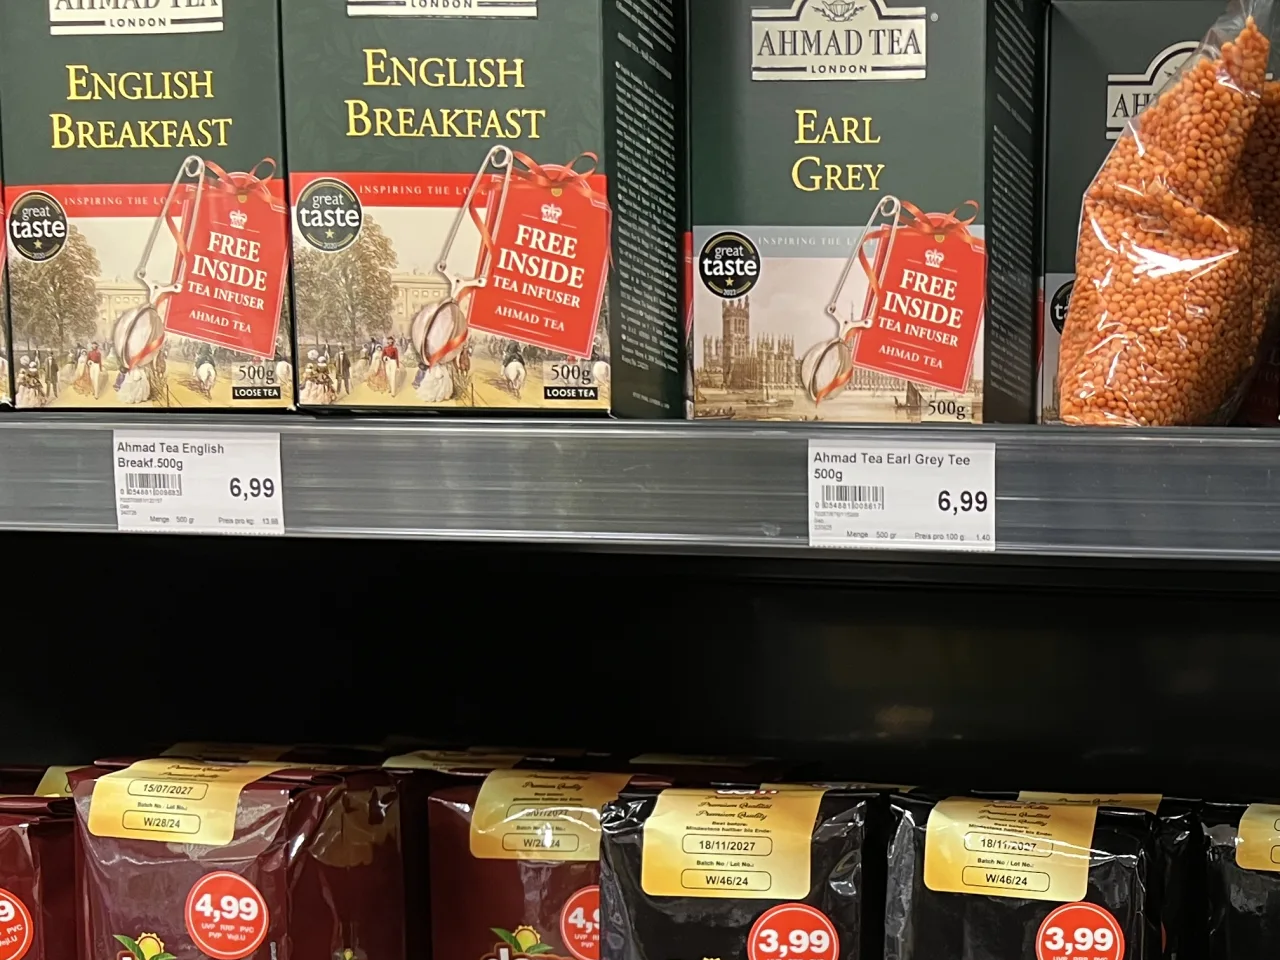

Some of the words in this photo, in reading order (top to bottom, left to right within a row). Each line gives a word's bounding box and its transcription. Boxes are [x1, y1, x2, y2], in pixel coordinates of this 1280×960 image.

[109, 18, 167, 28] LONDON
[757, 28, 863, 57] AHMAD
[868, 28, 922, 56] TEA
[362, 48, 525, 88] ENGLISH
[811, 64, 868, 74] LONDON
[65, 64, 214, 101] ENGLISH
[344, 99, 546, 139] BREAKFAST
[794, 109, 881, 145] EARL
[50, 113, 232, 149] BREAKFAST
[791, 156, 885, 192] GREY
[21, 206, 51, 221] great
[11, 217, 66, 239] taste
[208, 231, 261, 263] FREE
[191, 255, 267, 292] INSIDE
[187, 281, 211, 297] TEA
[213, 288, 264, 311] INFUSER
[188, 310, 229, 330] AHMAD
[232, 321, 252, 334] TEA
[238, 364, 275, 384] 500g
[550, 363, 592, 384] 500g
[546, 389, 574, 397] LOOSE
[575, 389, 595, 397] TEA
[927, 399, 966, 419] 500g
[117, 442, 156, 453] Ahmad
[159, 442, 179, 454] Tea
[182, 442, 224, 456] English
[813, 451, 857, 464] Ahmad
[861, 452, 883, 464] Tea
[886, 453, 911, 465] Earl
[914, 453, 944, 468] Grey
[948, 454, 971, 466] Tee
[814, 468, 843, 482] 500g
[229, 477, 275, 501] 6,99
[938, 490, 988, 515] 6,99
[142, 781, 194, 796] 15/07/2027
[143, 817, 181, 829] W/28/24
[699, 840, 756, 852] 18/11/2027
[706, 875, 749, 886] W/46/24
[985, 873, 1029, 888] W/46/24
[195, 893, 259, 925] 4,99
[758, 928, 830, 958] 3,99
[1043, 925, 1114, 958] 3,99
